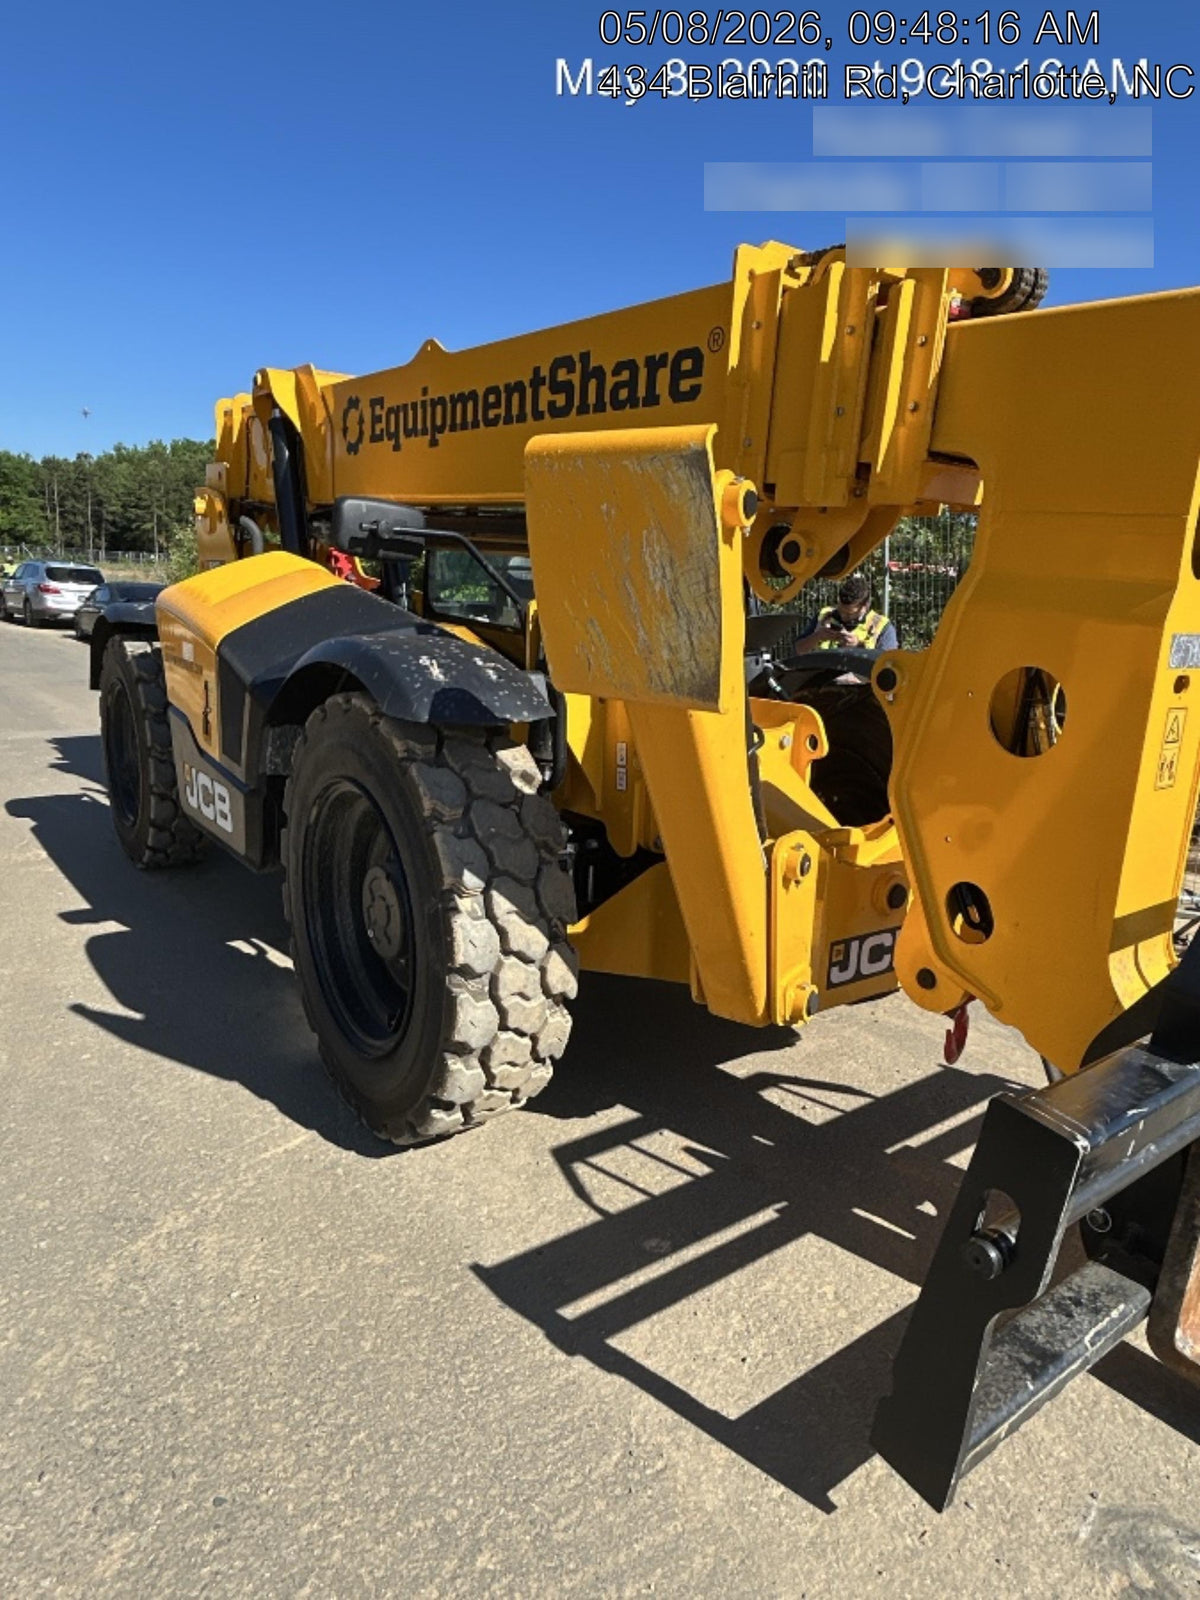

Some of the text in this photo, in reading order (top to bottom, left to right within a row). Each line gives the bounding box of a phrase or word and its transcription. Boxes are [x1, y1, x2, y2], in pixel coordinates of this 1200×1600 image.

[368, 345, 705, 452] EquipmentShare
[184, 763, 233, 833] JCB
[829, 930, 900, 984] JC
